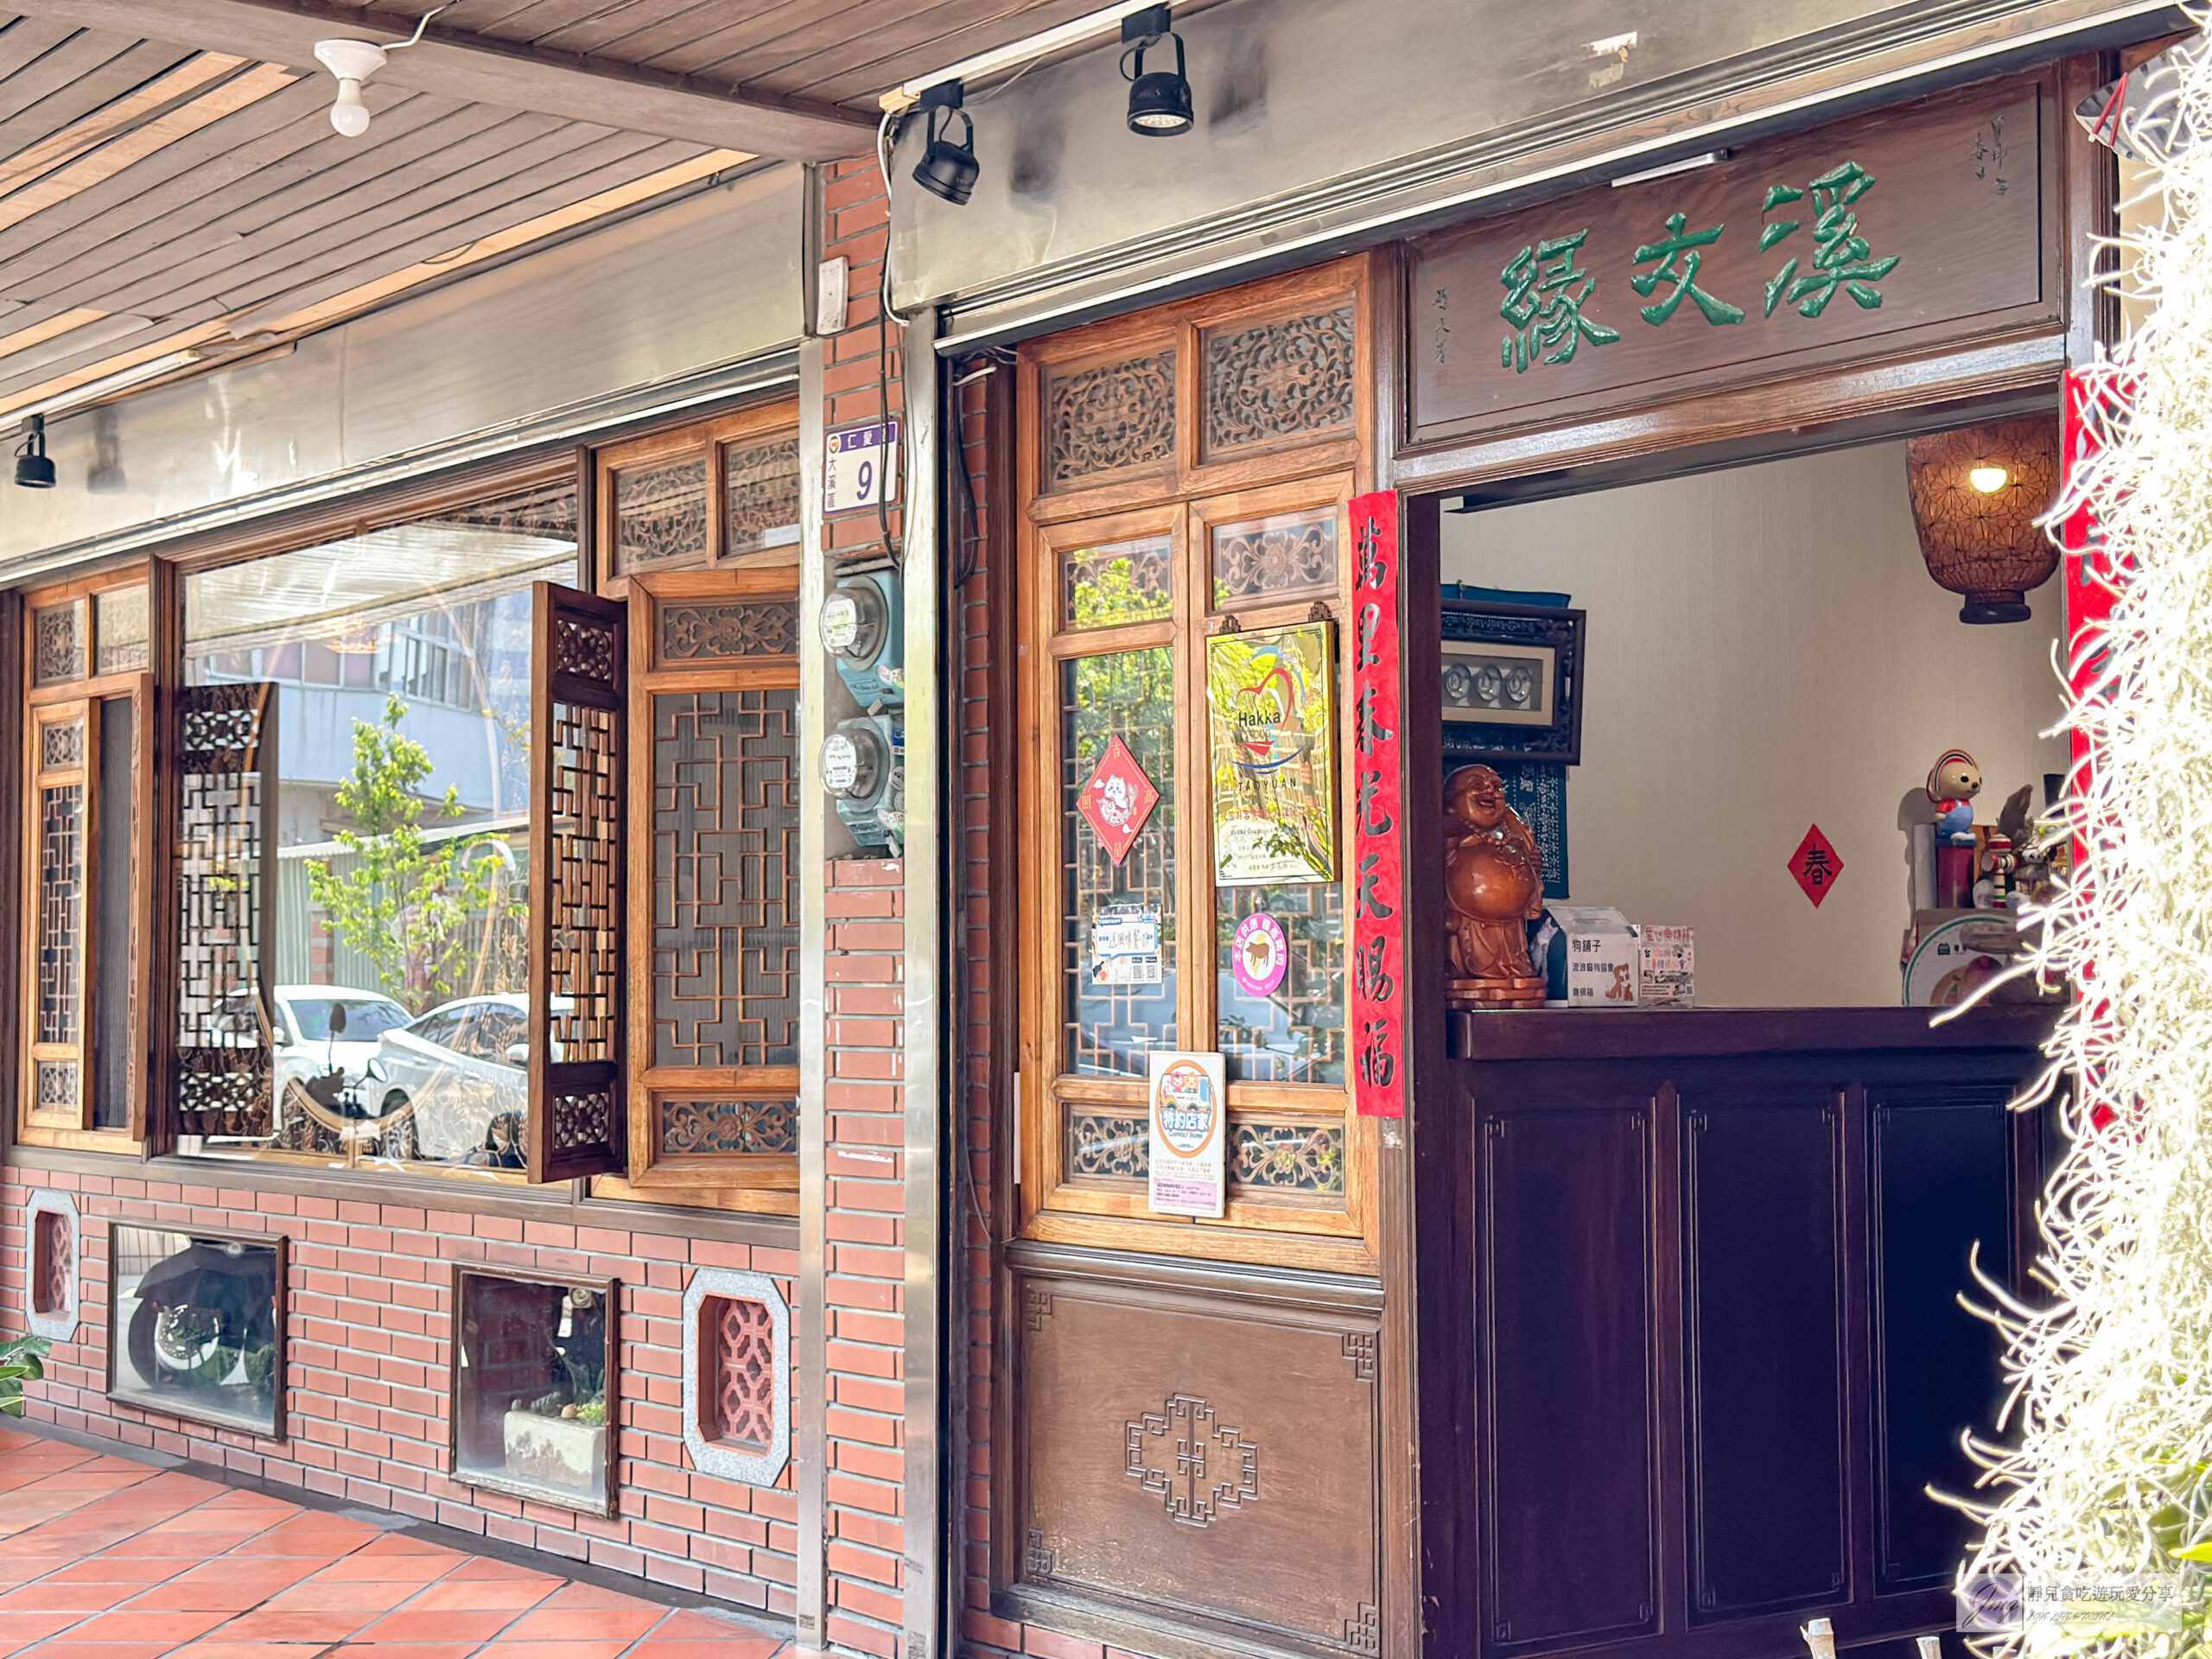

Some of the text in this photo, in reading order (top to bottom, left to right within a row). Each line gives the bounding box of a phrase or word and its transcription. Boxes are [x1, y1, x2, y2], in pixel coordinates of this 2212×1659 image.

[827, 457, 837, 508] 大溪區
[856, 461, 873, 501] 9
[1238, 709, 1281, 728] Hakka
[1238, 778, 1296, 792] TAOYUAN
[1804, 843, 1832, 885] 春
[1162, 1110, 1209, 1131] 特約店家
